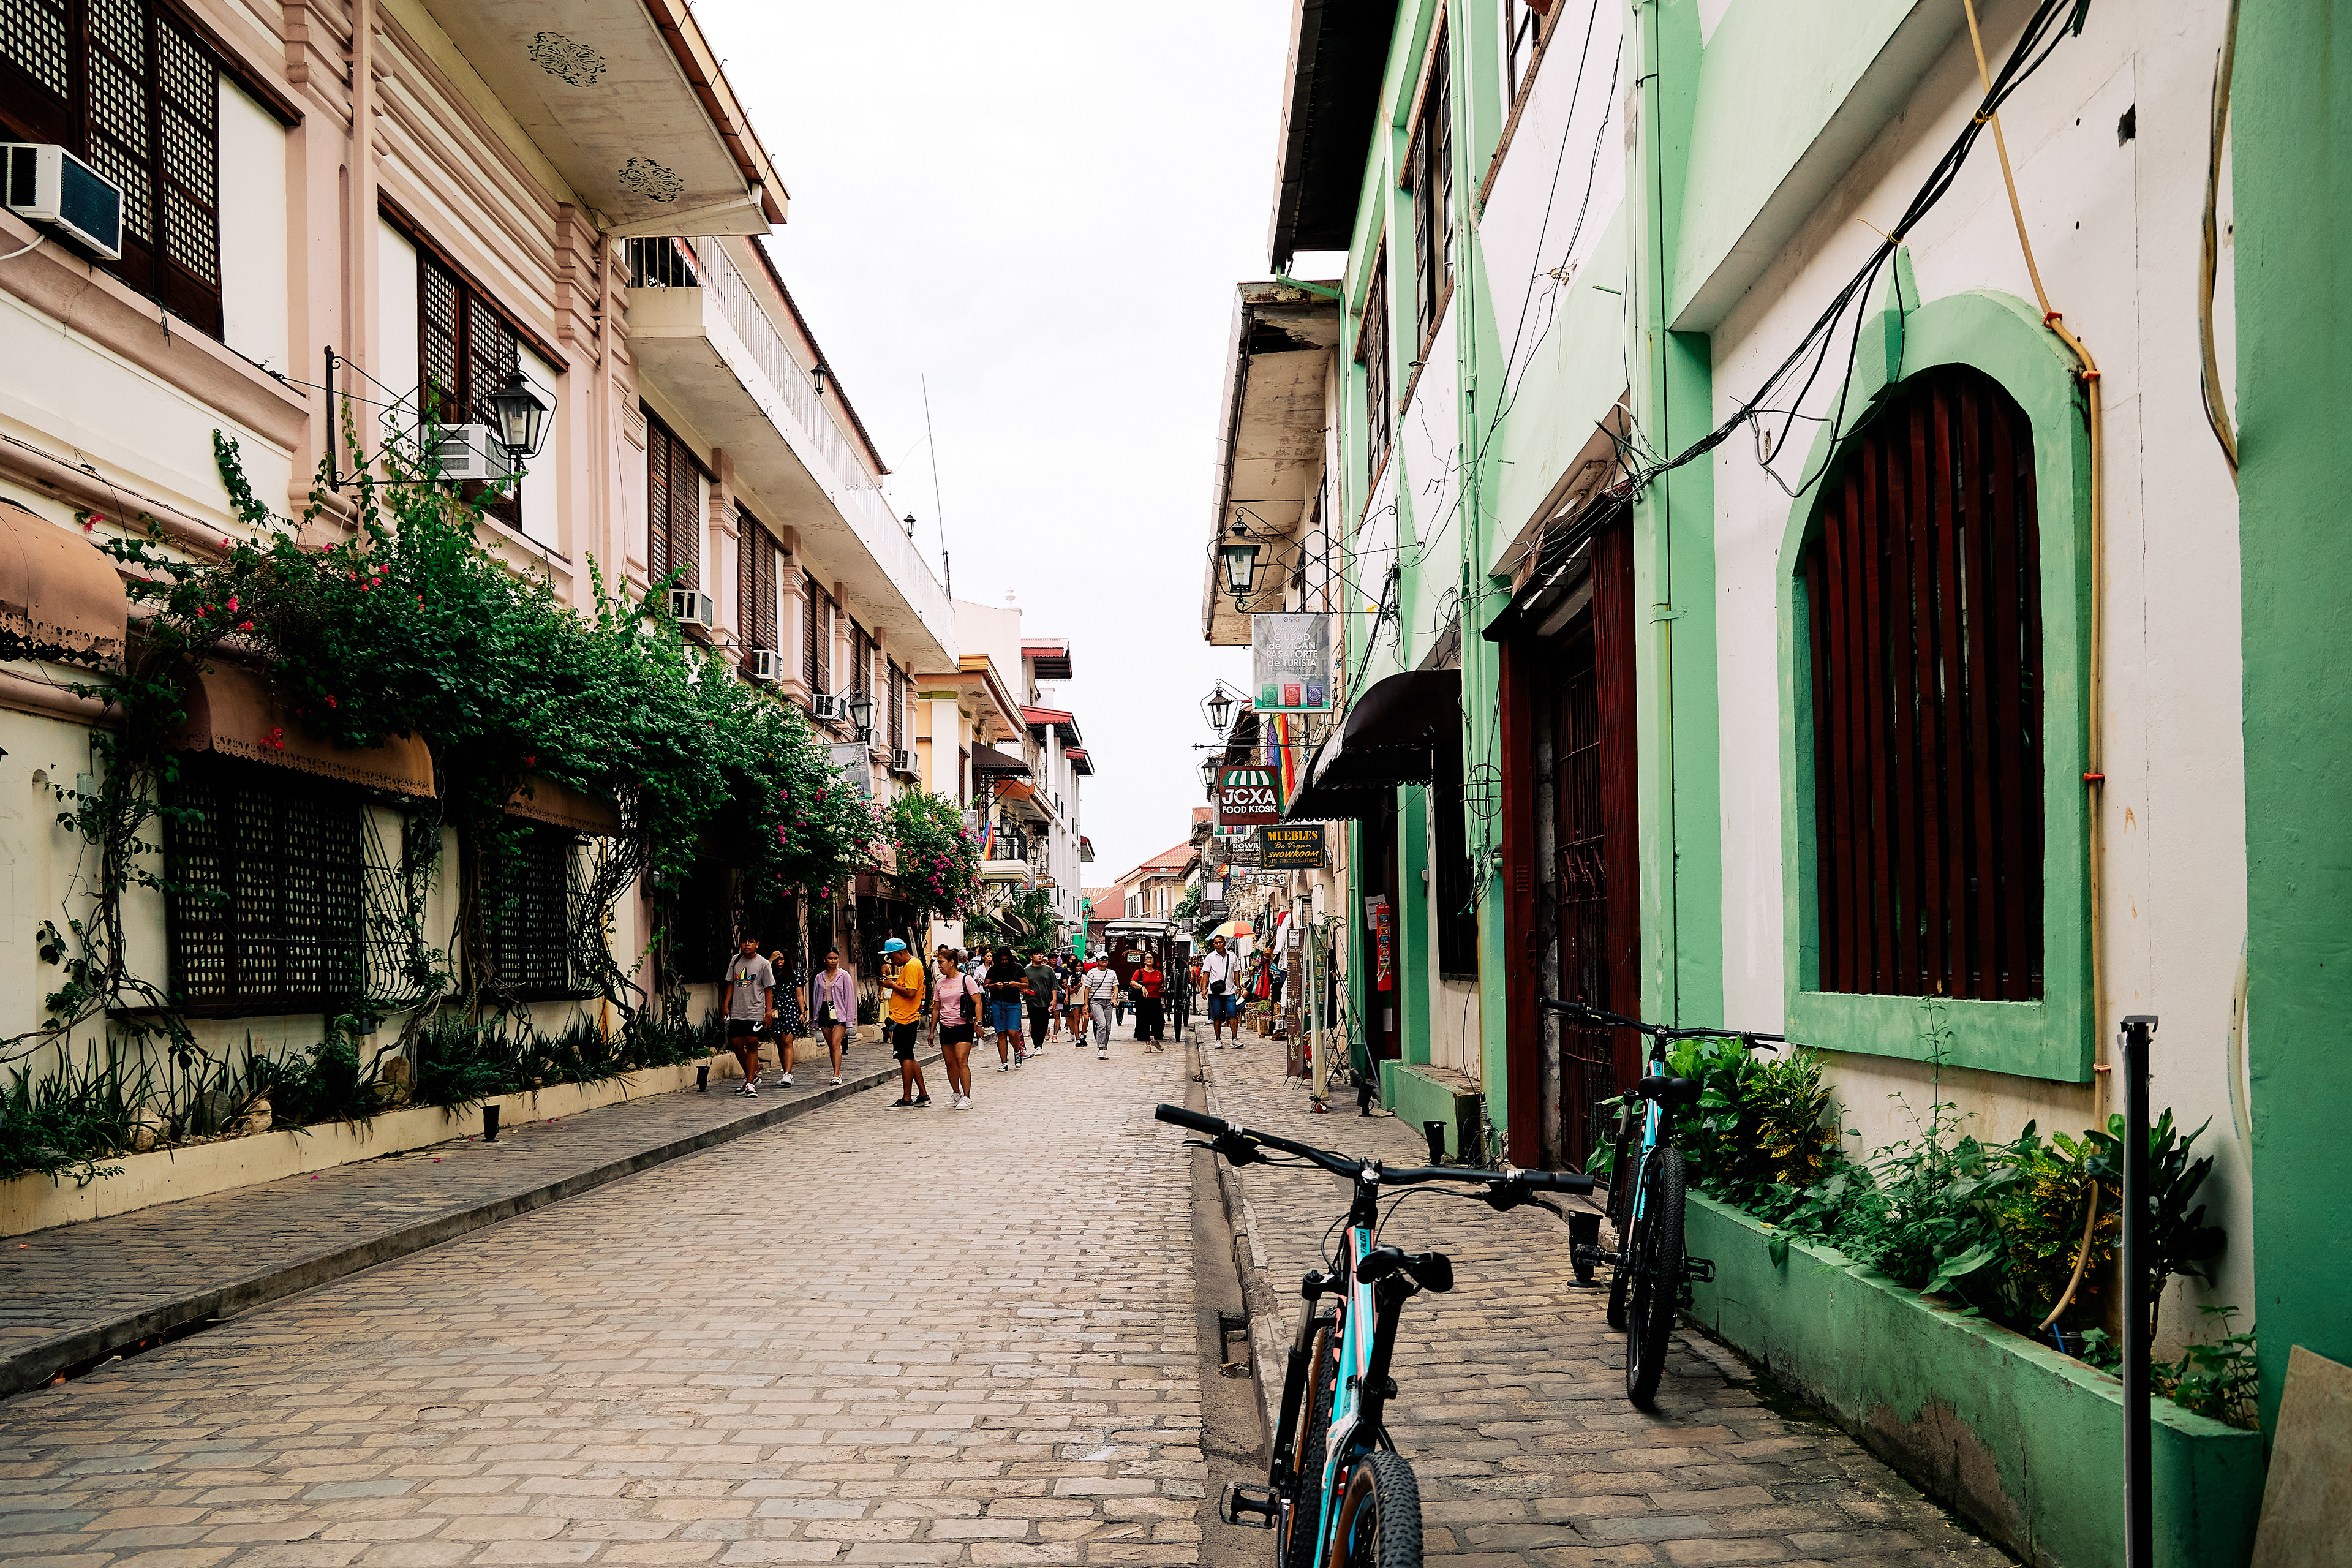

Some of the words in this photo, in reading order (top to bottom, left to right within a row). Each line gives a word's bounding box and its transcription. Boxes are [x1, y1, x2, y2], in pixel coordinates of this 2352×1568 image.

[1221, 788, 1276, 804] JCXA
[1267, 831, 1318, 841] MUEBLES
[1287, 841, 1312, 851] Vigan
